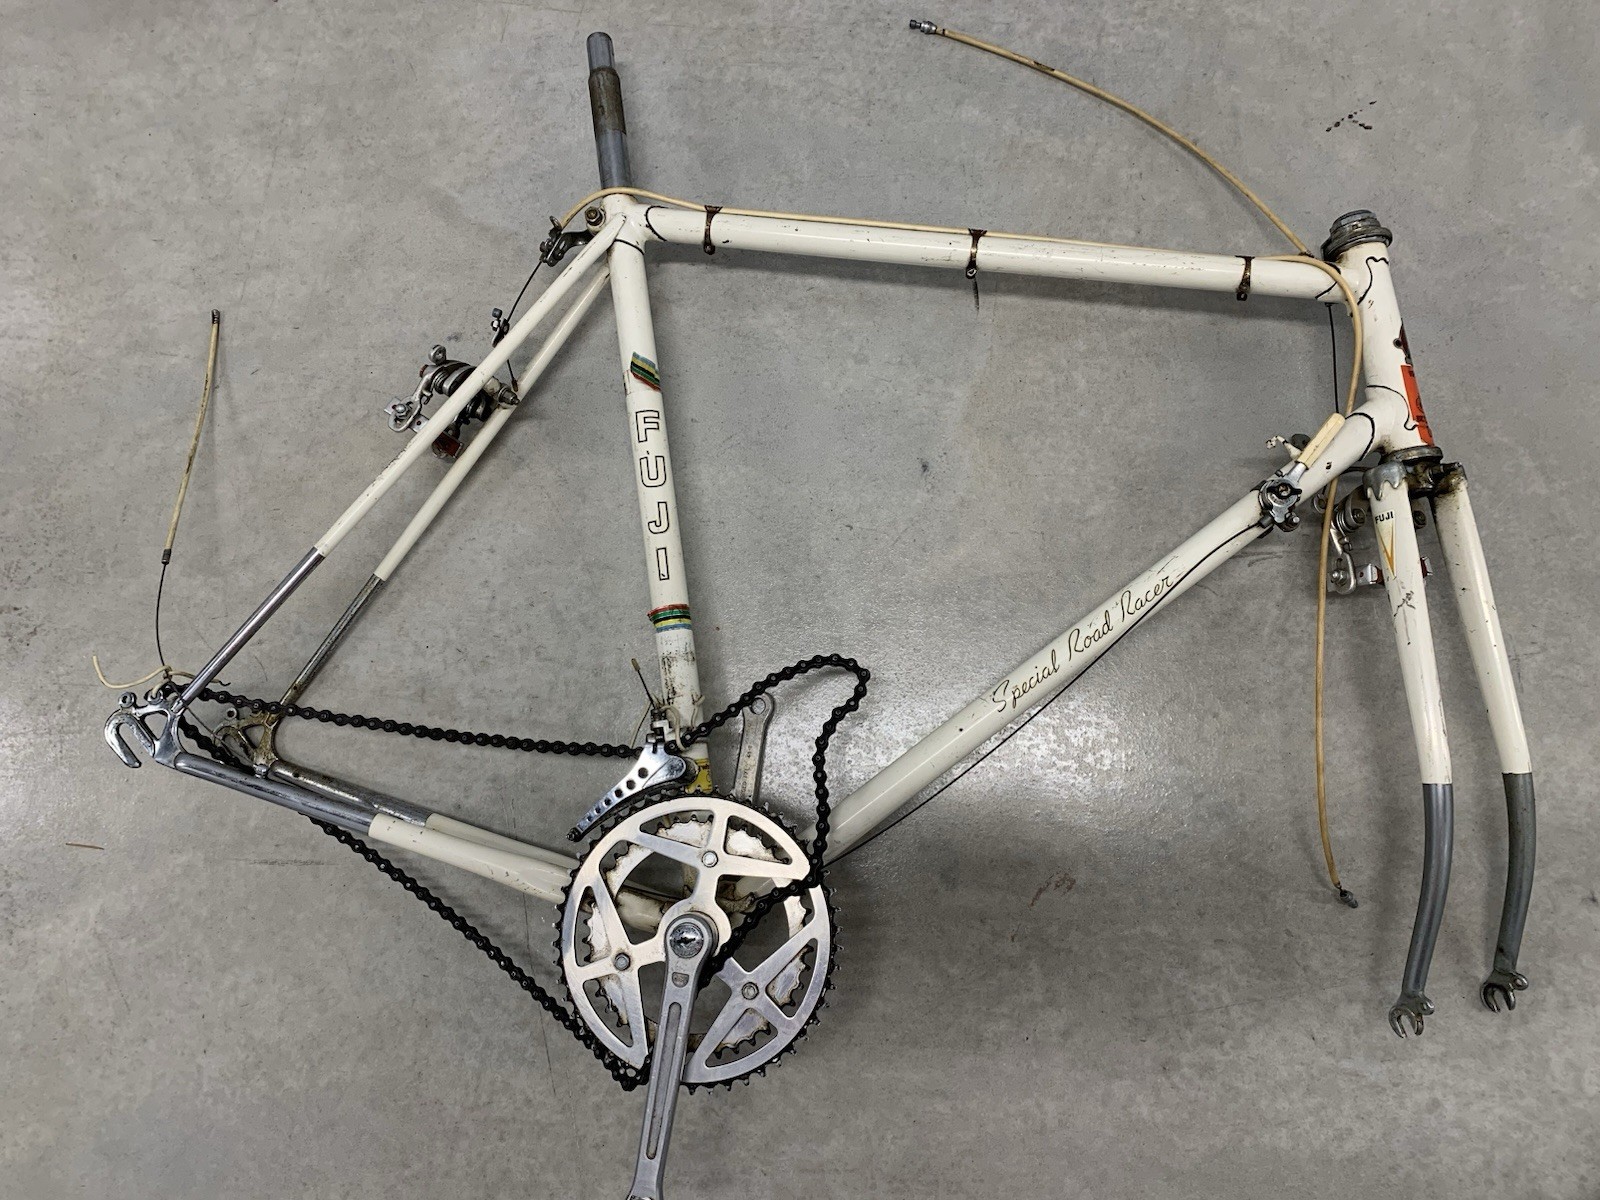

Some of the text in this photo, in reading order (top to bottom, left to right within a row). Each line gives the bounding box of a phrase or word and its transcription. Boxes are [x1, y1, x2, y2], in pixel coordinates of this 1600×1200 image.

[635, 409, 670, 581] FUJI
[1374, 511, 1394, 524] FUJI
[991, 575, 1174, 713] Special Road Racer
